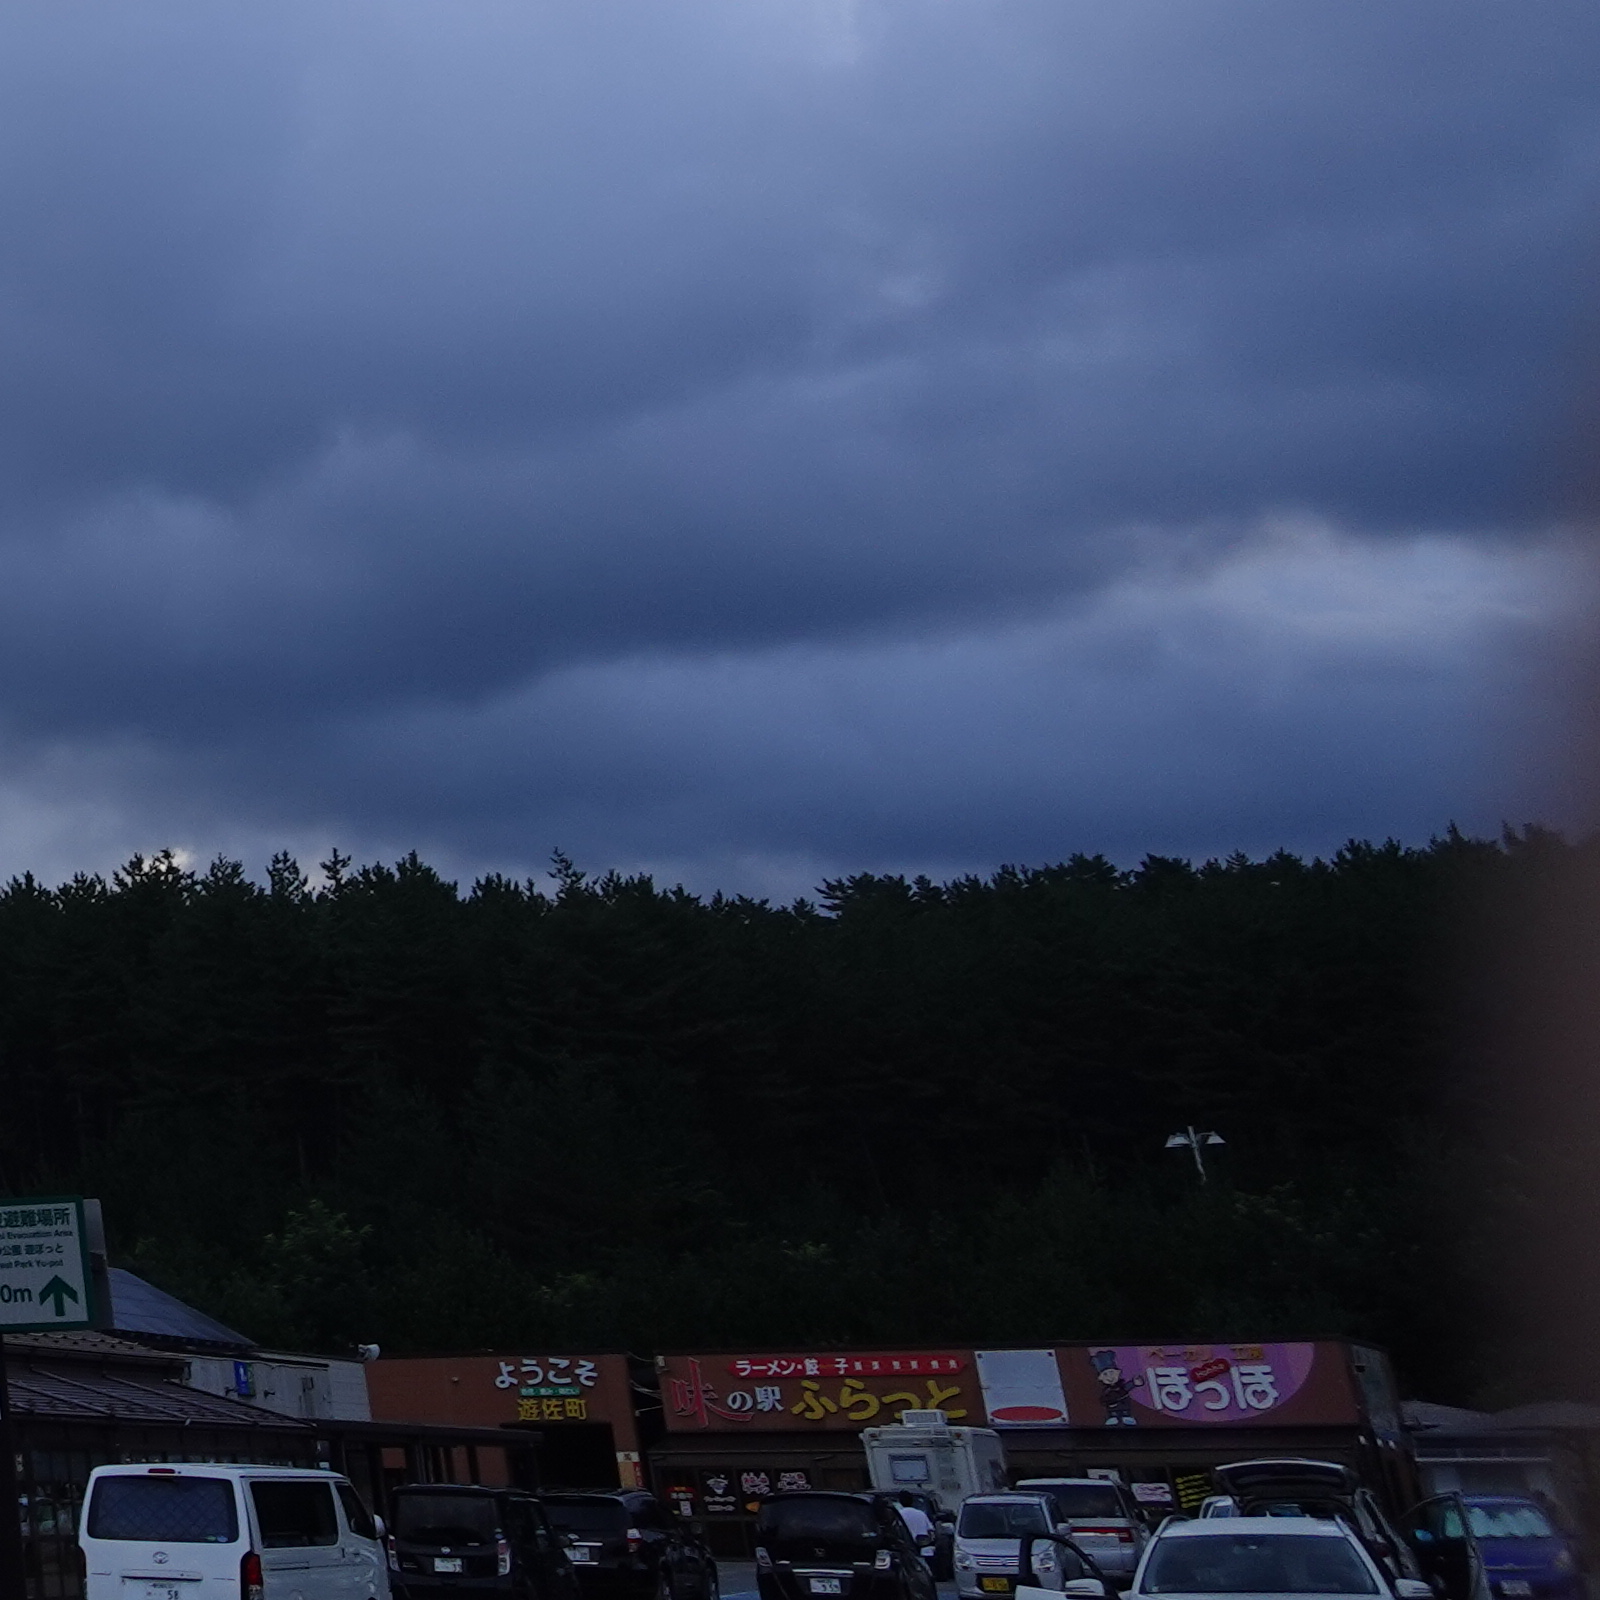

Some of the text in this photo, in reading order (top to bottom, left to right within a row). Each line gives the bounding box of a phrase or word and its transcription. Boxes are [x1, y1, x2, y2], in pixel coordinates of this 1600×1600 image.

[494, 1357, 599, 1389] ようこそ
[669, 1356, 968, 1428] 味の駅 ふらっと
[516, 1398, 588, 1422] 遊佐町
